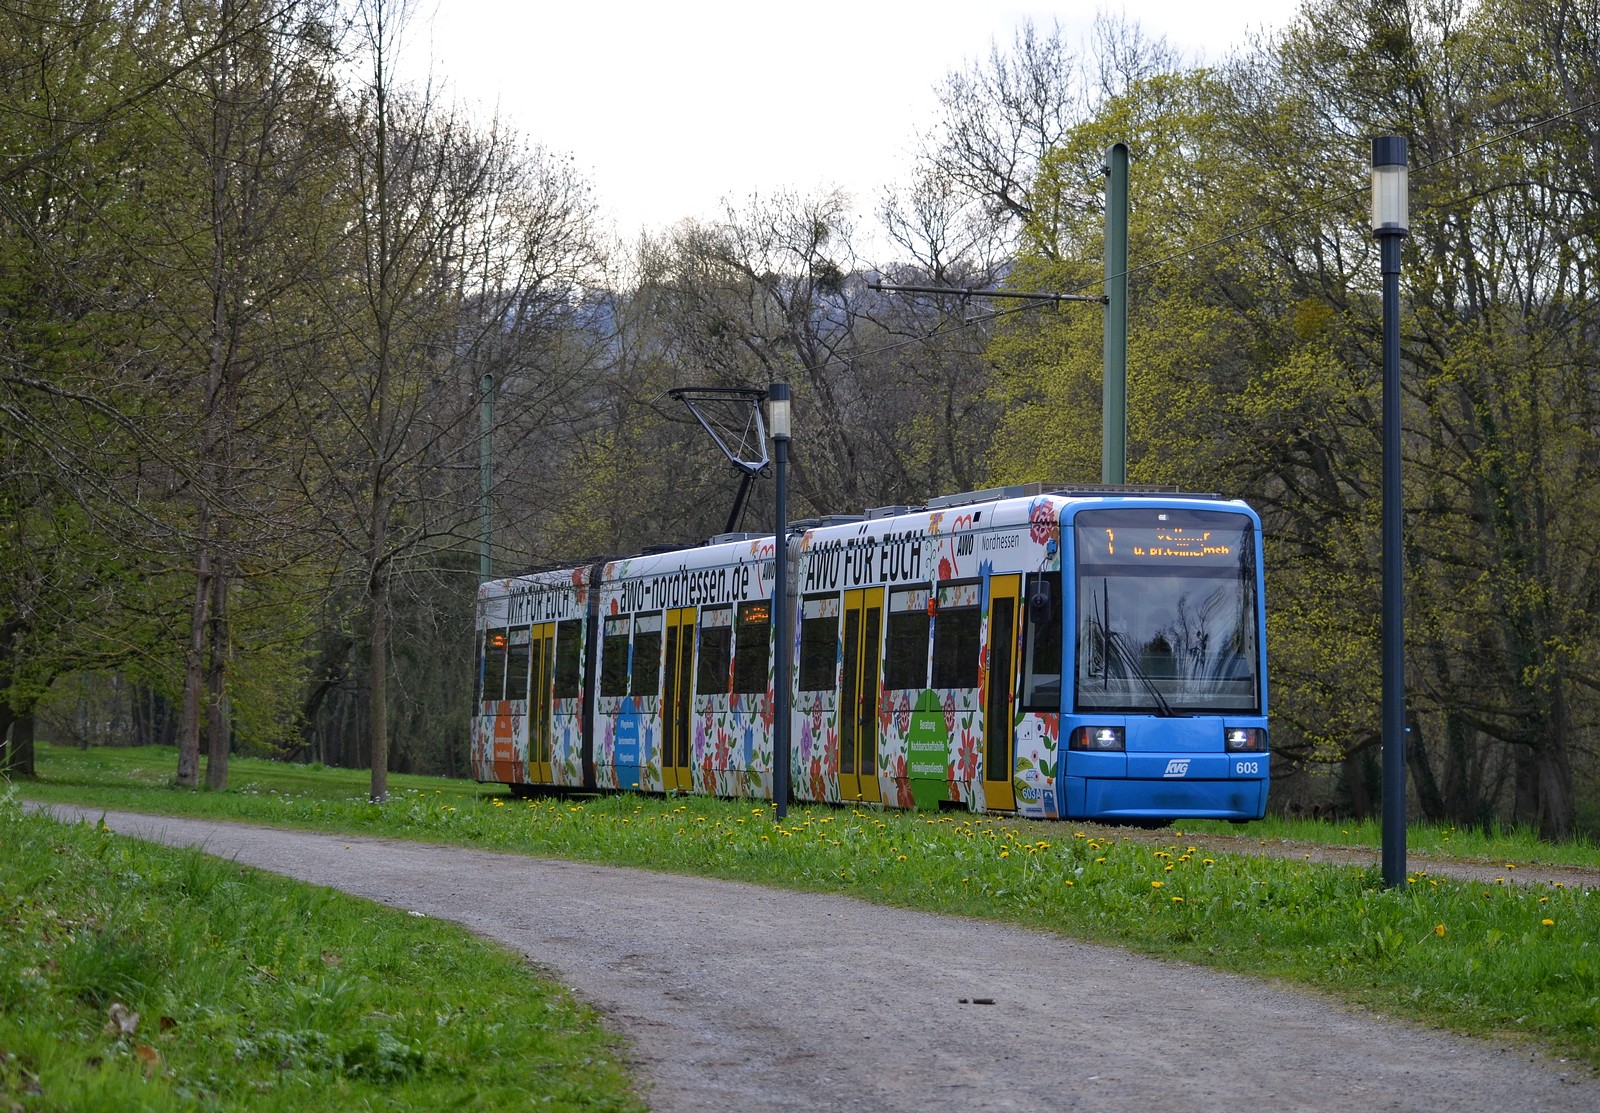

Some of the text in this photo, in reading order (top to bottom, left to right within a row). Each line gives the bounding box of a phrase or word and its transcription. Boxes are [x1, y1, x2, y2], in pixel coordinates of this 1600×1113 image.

[957, 534, 974, 556] AWO
[982, 533, 1020, 551] Nordhessen
[805, 524, 925, 591] AWO FÜR EUCH
[620, 557, 749, 613] awo-nordhessen.de
[507, 577, 571, 624] WIR FÜR EUCH
[1164, 761, 1190, 775] KVG
[1236, 761, 1259, 775] 603
